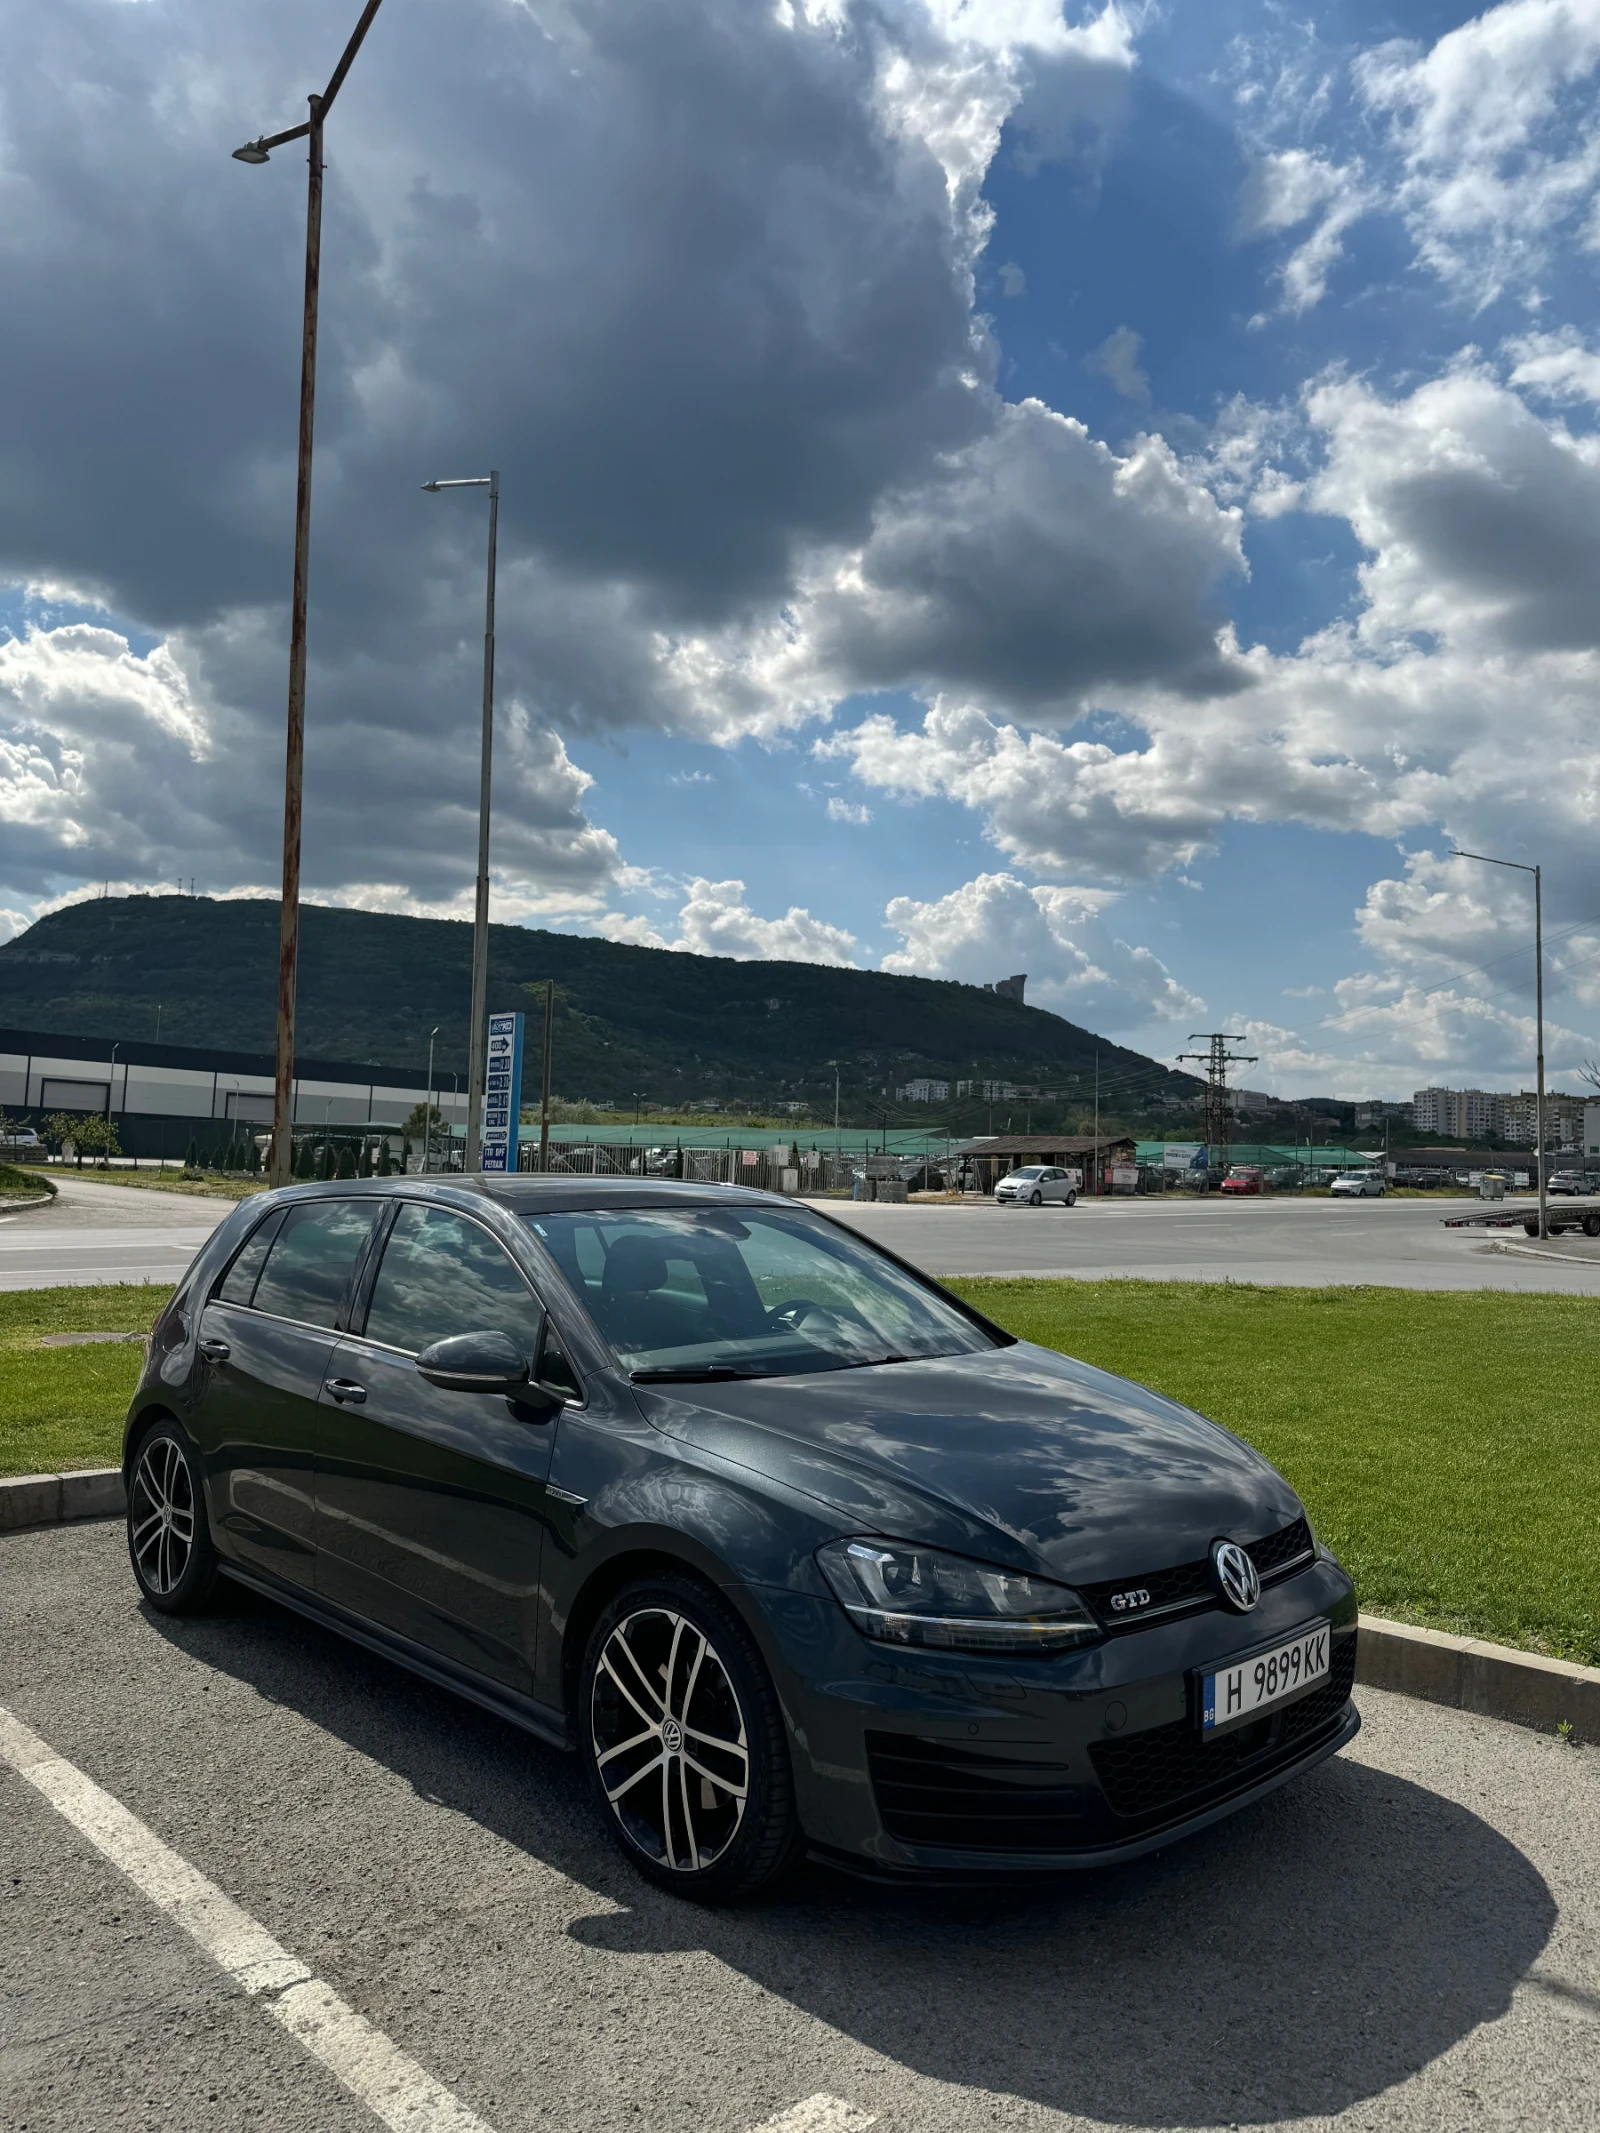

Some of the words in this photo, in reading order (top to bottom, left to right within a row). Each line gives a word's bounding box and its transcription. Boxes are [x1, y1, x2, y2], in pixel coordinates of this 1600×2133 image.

[491, 1041, 501, 1050] 400
[495, 1147, 506, 1157] DPF
[1111, 1589, 1150, 1611] GTD
[1227, 1669, 1243, 1715] H
[1203, 1707, 1214, 1723] BG
